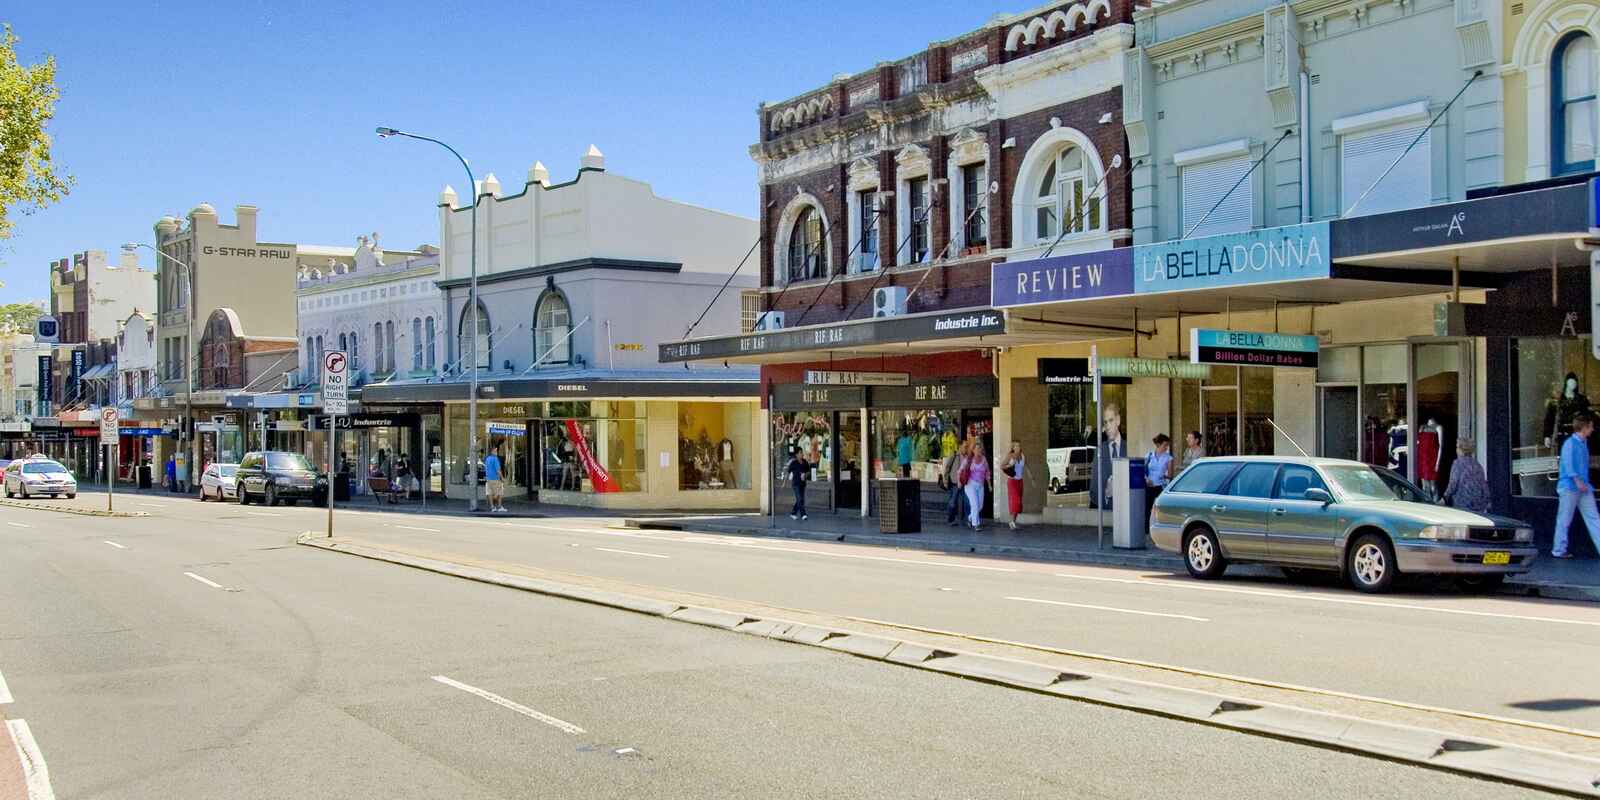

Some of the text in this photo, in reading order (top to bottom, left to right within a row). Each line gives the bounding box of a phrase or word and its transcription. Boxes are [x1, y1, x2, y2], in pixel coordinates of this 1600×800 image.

[259, 249, 290, 259] RAW
[1143, 236, 1322, 281] LABELLADONNA
[1017, 264, 1103, 294] REVIEW
[935, 314, 999, 331] industrie inc.
[815, 330, 826, 344] RIF
[741, 338, 750, 351] RIF
[1215, 351, 1245, 361] Billion
[1248, 353, 1274, 362] Dollar
[328, 375, 342, 383] NO
[813, 371, 831, 383] RIF
[802, 390, 813, 402] RIF
[915, 386, 927, 400] RIF
[503, 406, 525, 414] DIESEL
